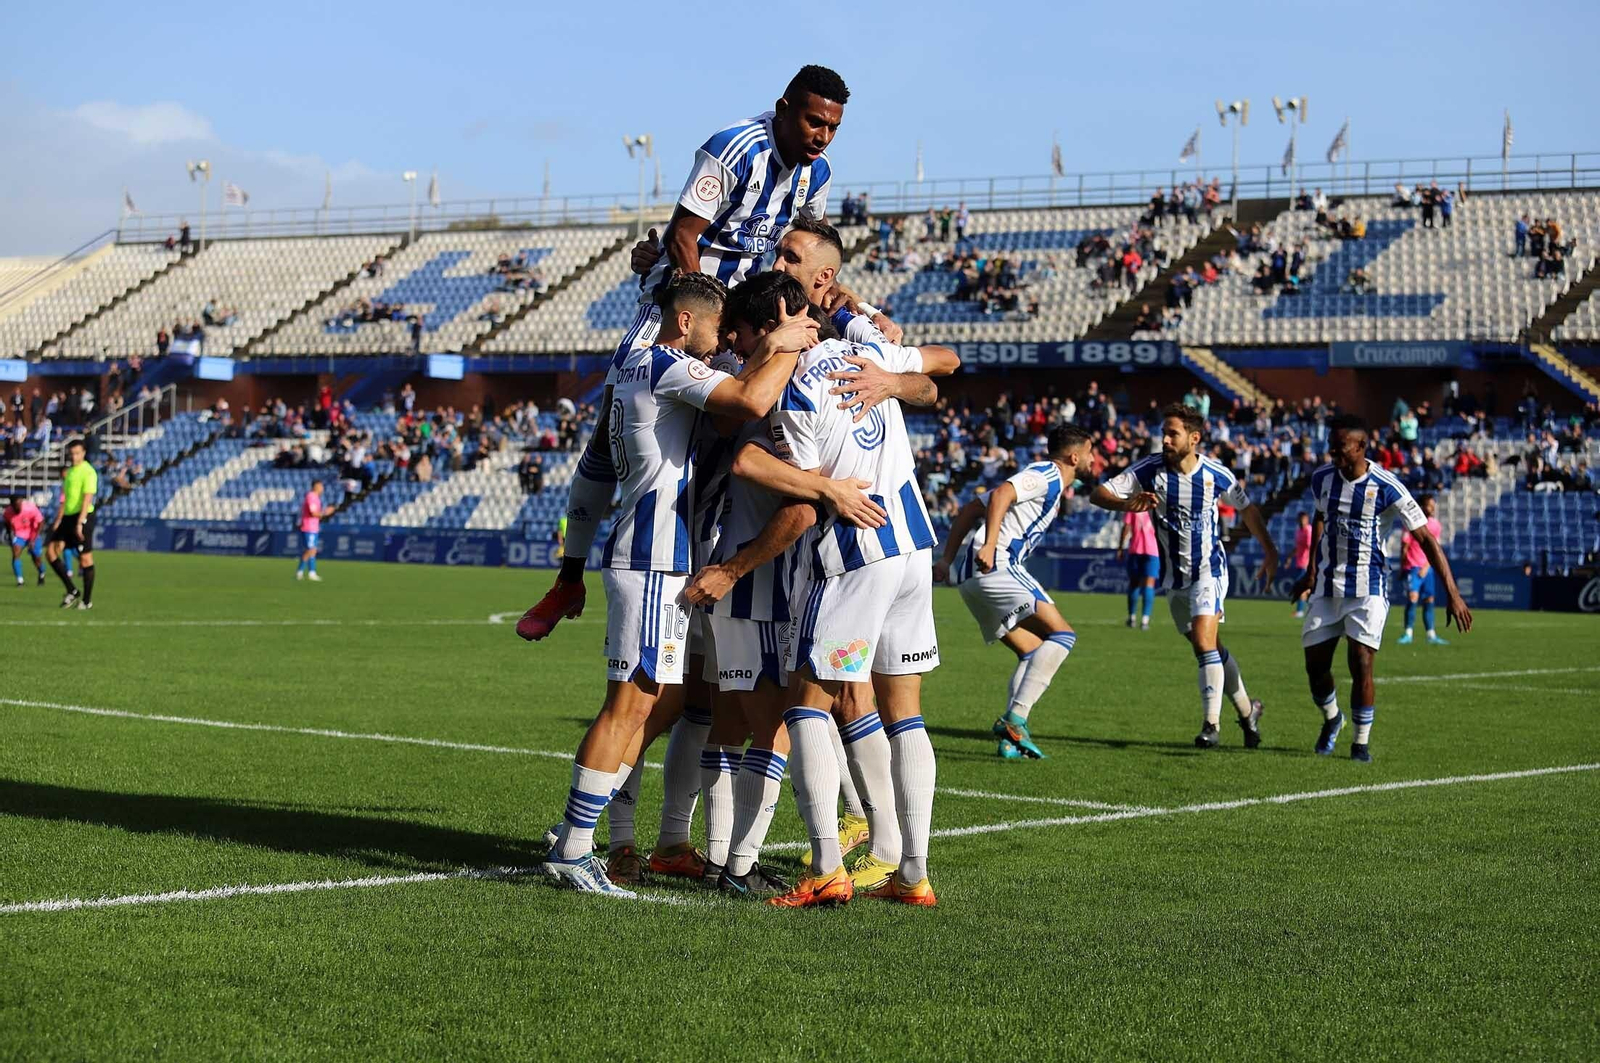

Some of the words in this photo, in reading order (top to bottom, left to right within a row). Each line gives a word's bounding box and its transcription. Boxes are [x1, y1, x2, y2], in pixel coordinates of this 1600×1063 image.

[1057, 342, 1158, 363] 1889
[1354, 343, 1447, 365] Cruzcampo
[193, 530, 248, 547] Planasa
[664, 604, 686, 640] 18
[608, 659, 628, 670] ERO
